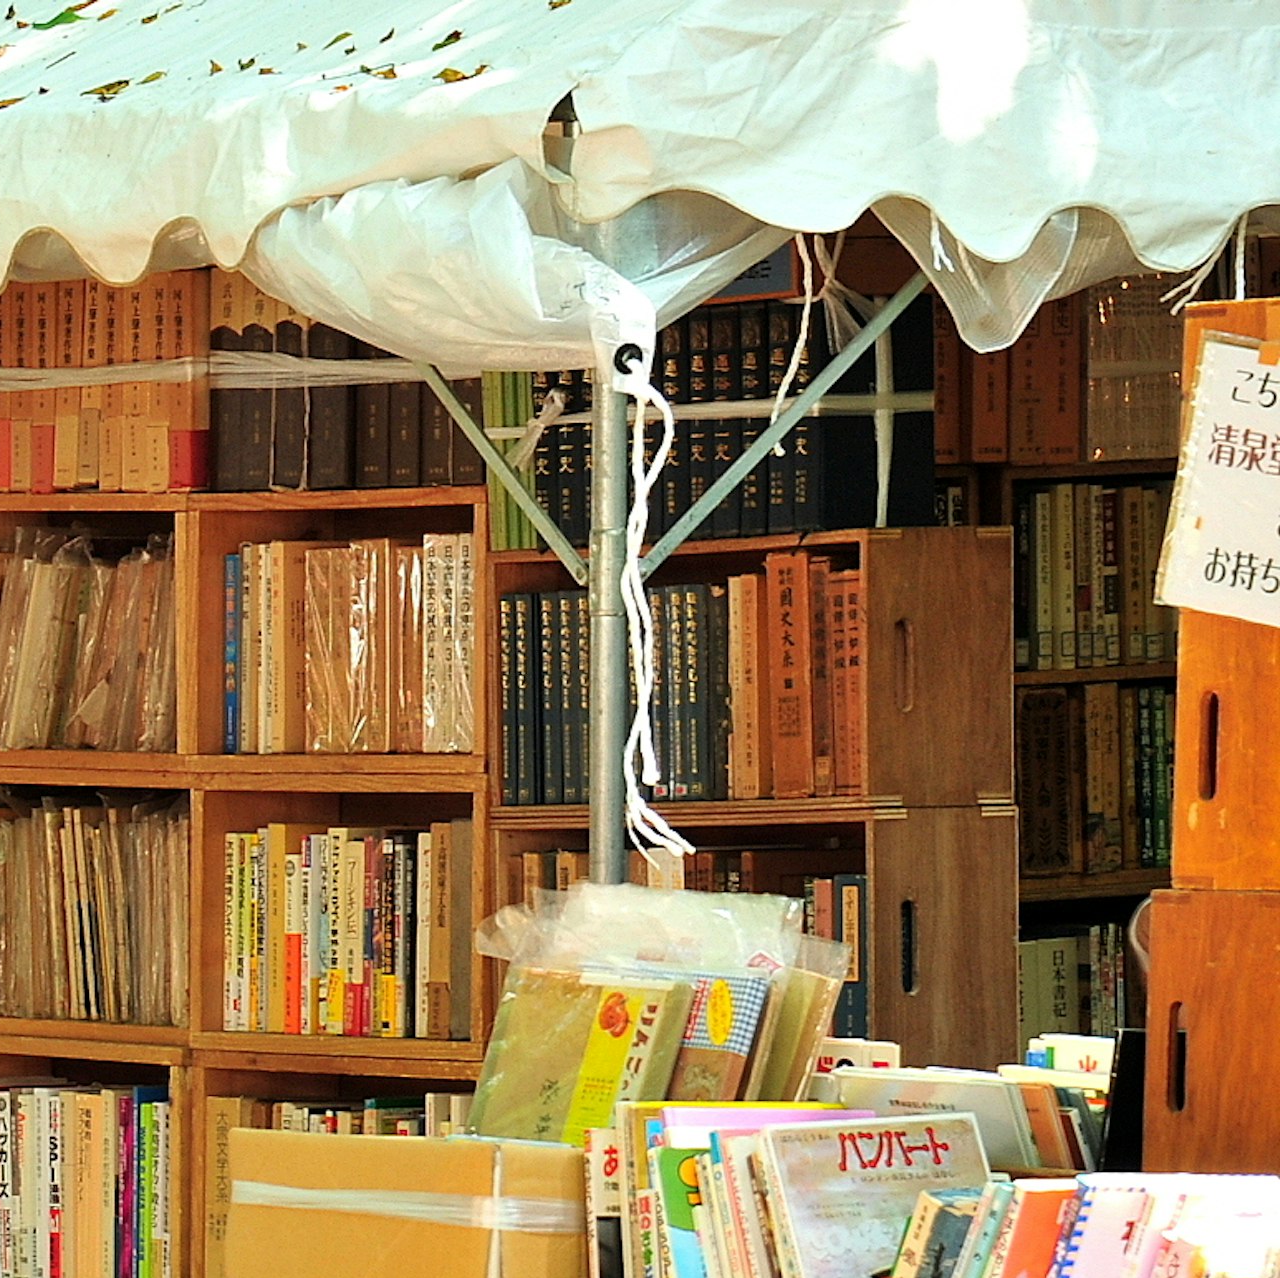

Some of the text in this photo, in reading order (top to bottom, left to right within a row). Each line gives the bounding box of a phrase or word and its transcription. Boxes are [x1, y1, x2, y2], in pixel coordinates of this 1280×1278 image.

[838, 1126, 949, 1172] ハンバート
